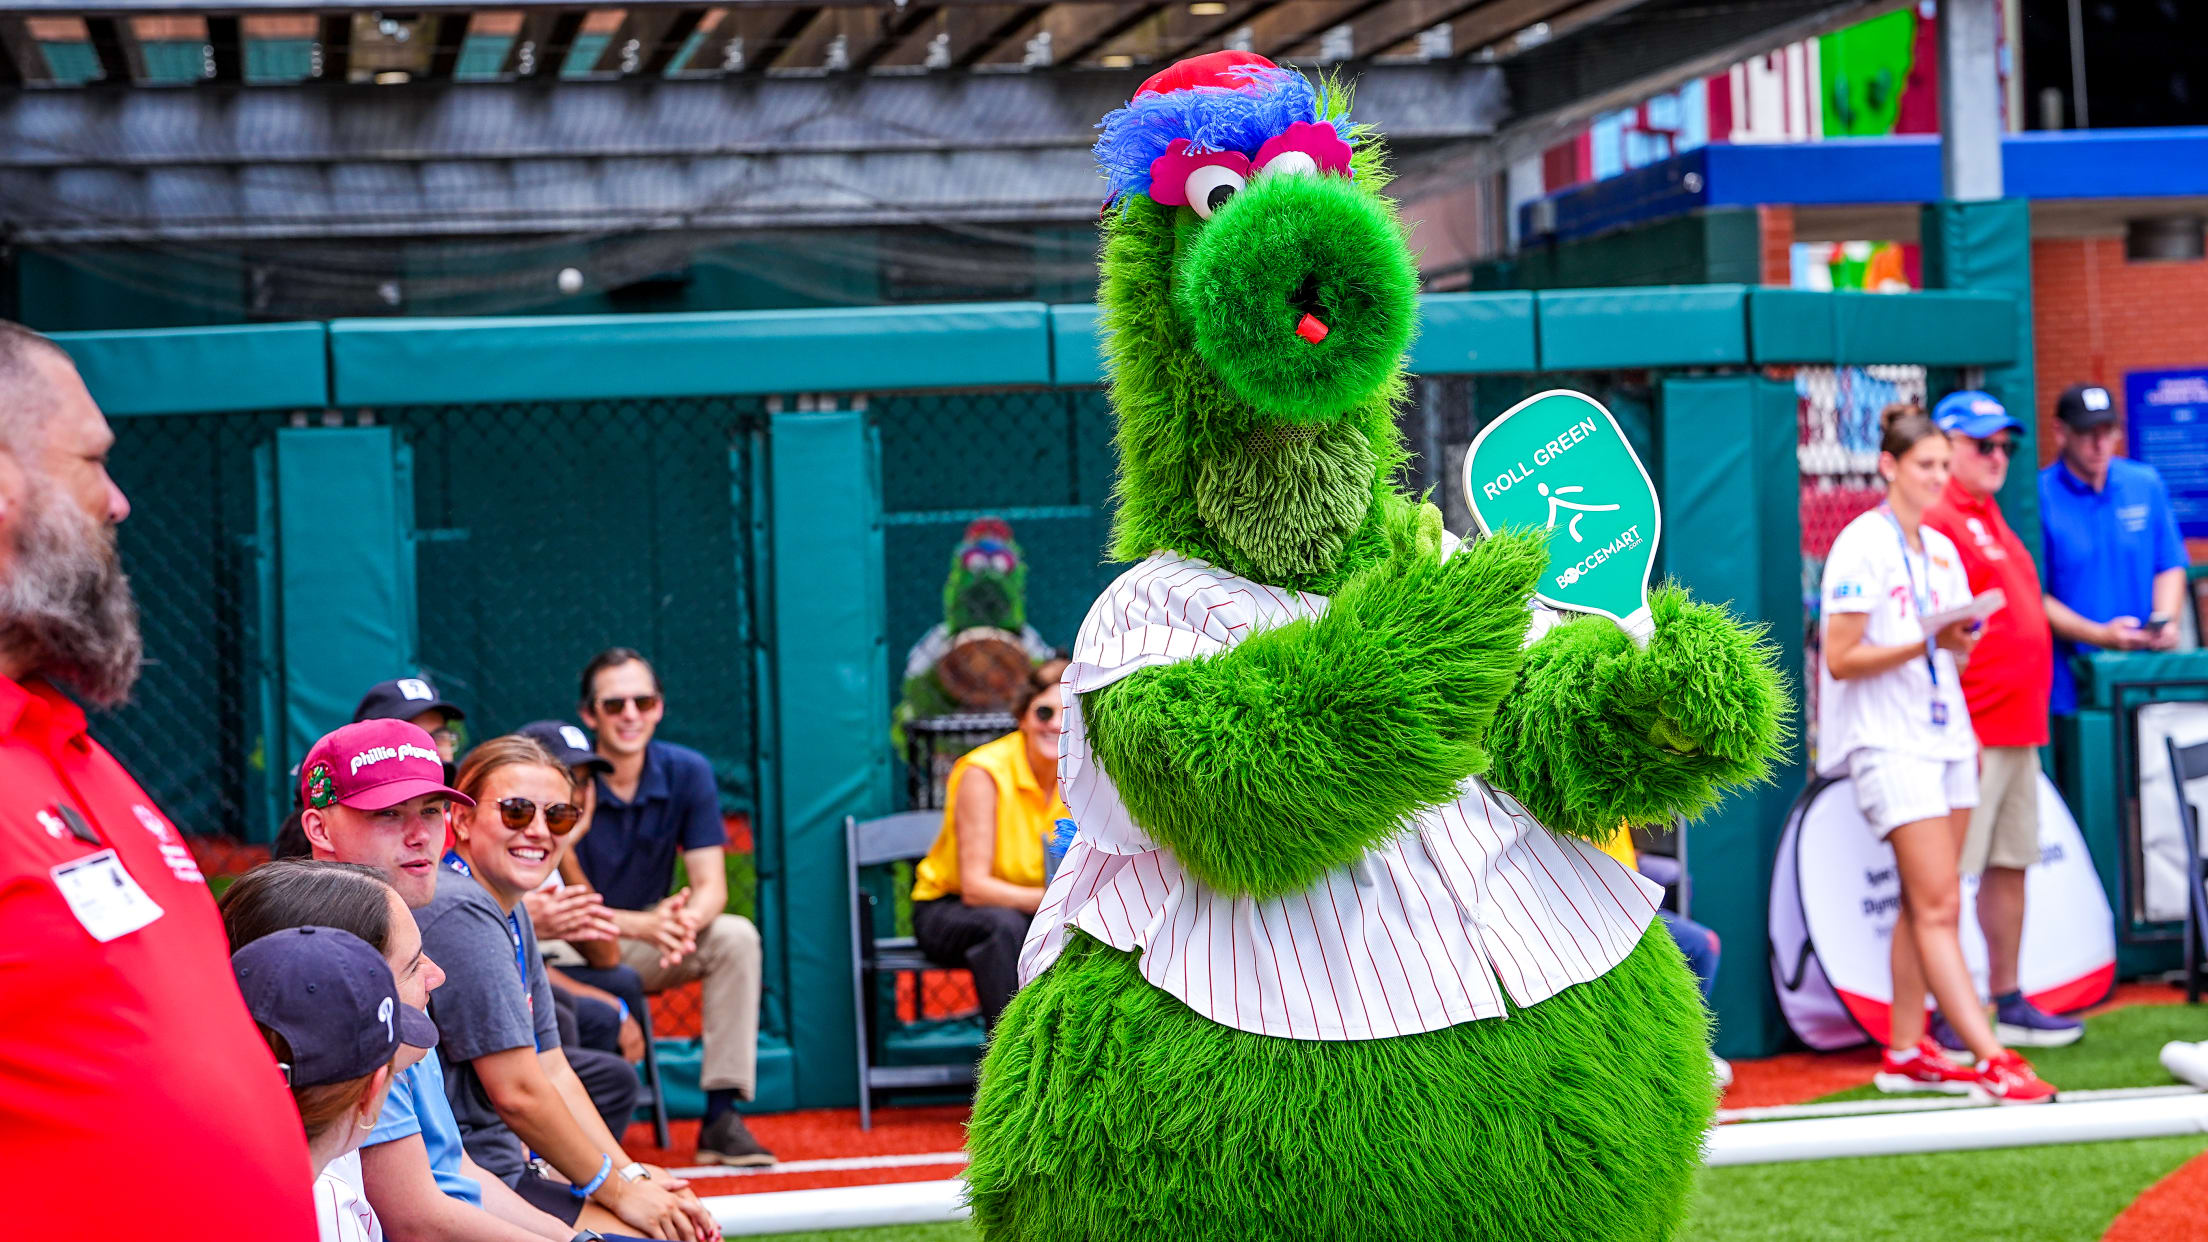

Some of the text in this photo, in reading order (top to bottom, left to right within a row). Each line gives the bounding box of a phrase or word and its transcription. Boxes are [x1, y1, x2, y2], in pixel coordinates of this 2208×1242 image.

[1483, 416, 1597, 500] ROLL GREEN
[1555, 525, 1642, 590] BOCCEMART
[350, 746, 397, 776] phillie
[377, 996, 393, 1043] P
